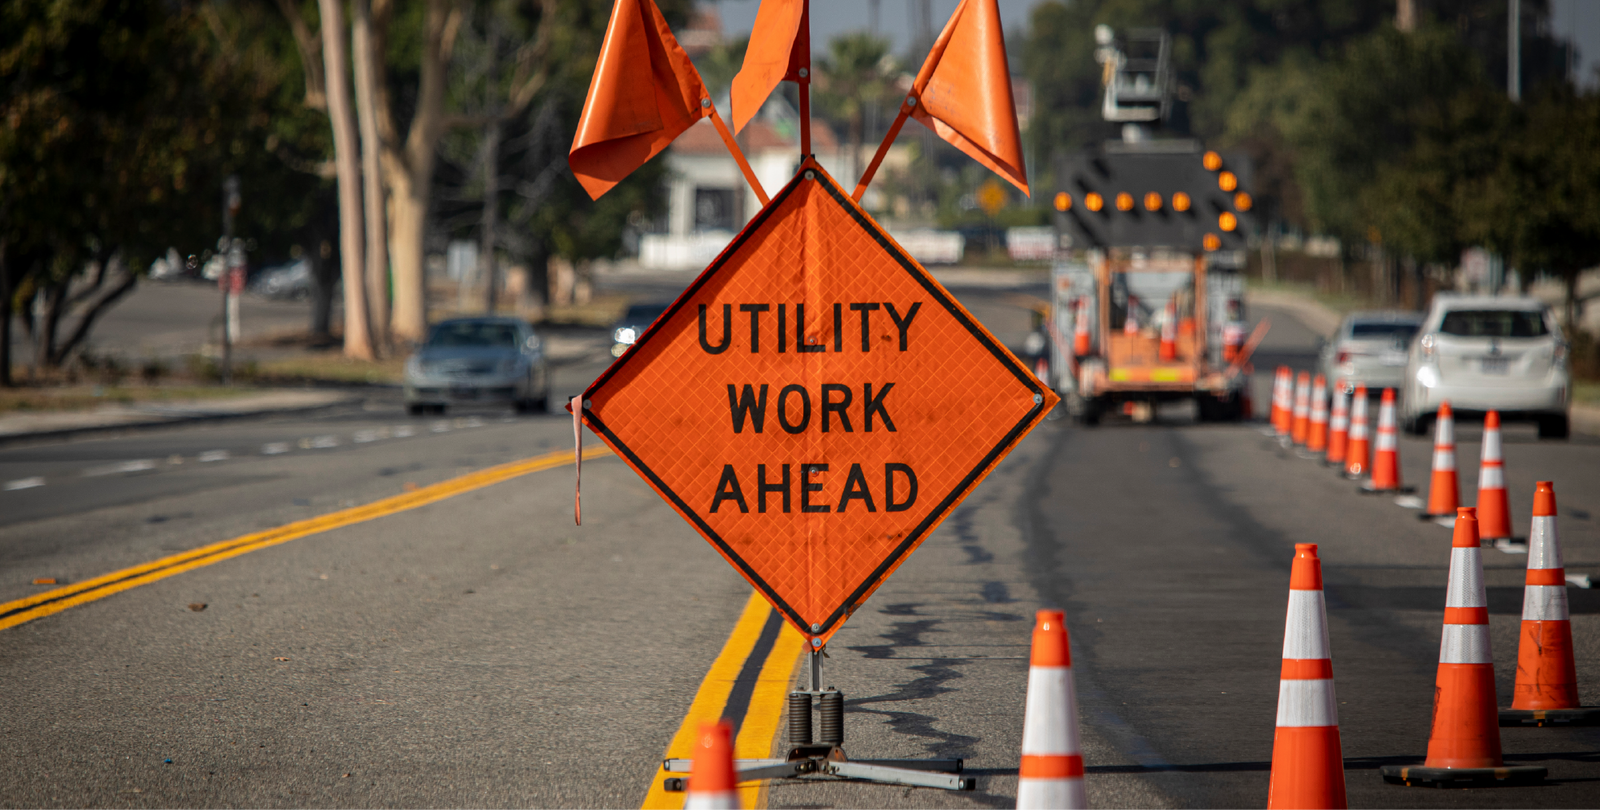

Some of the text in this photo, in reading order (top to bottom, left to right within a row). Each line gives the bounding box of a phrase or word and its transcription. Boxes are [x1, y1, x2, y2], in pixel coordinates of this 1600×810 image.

[697, 301, 923, 355] UTILITY
[727, 382, 897, 435] WORK
[709, 462, 919, 514] AHEAD
